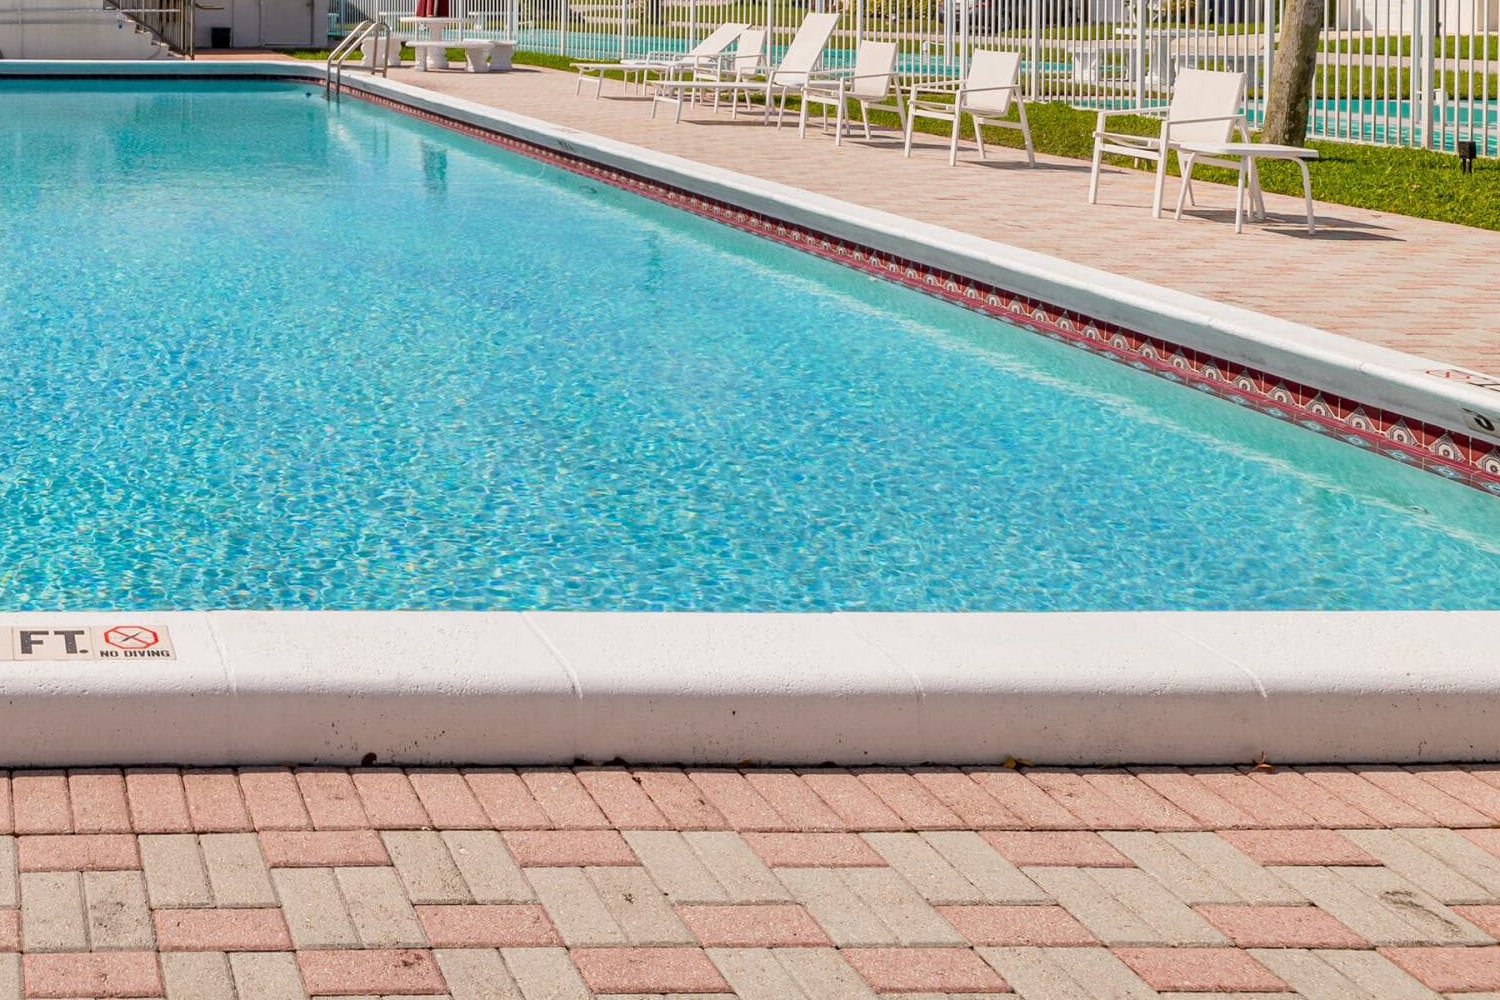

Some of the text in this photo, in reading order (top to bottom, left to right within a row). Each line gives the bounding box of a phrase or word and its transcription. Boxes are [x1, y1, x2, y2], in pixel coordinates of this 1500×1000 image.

[19, 630, 89, 654] FT.
[99, 650, 171, 658] NO DIVING
